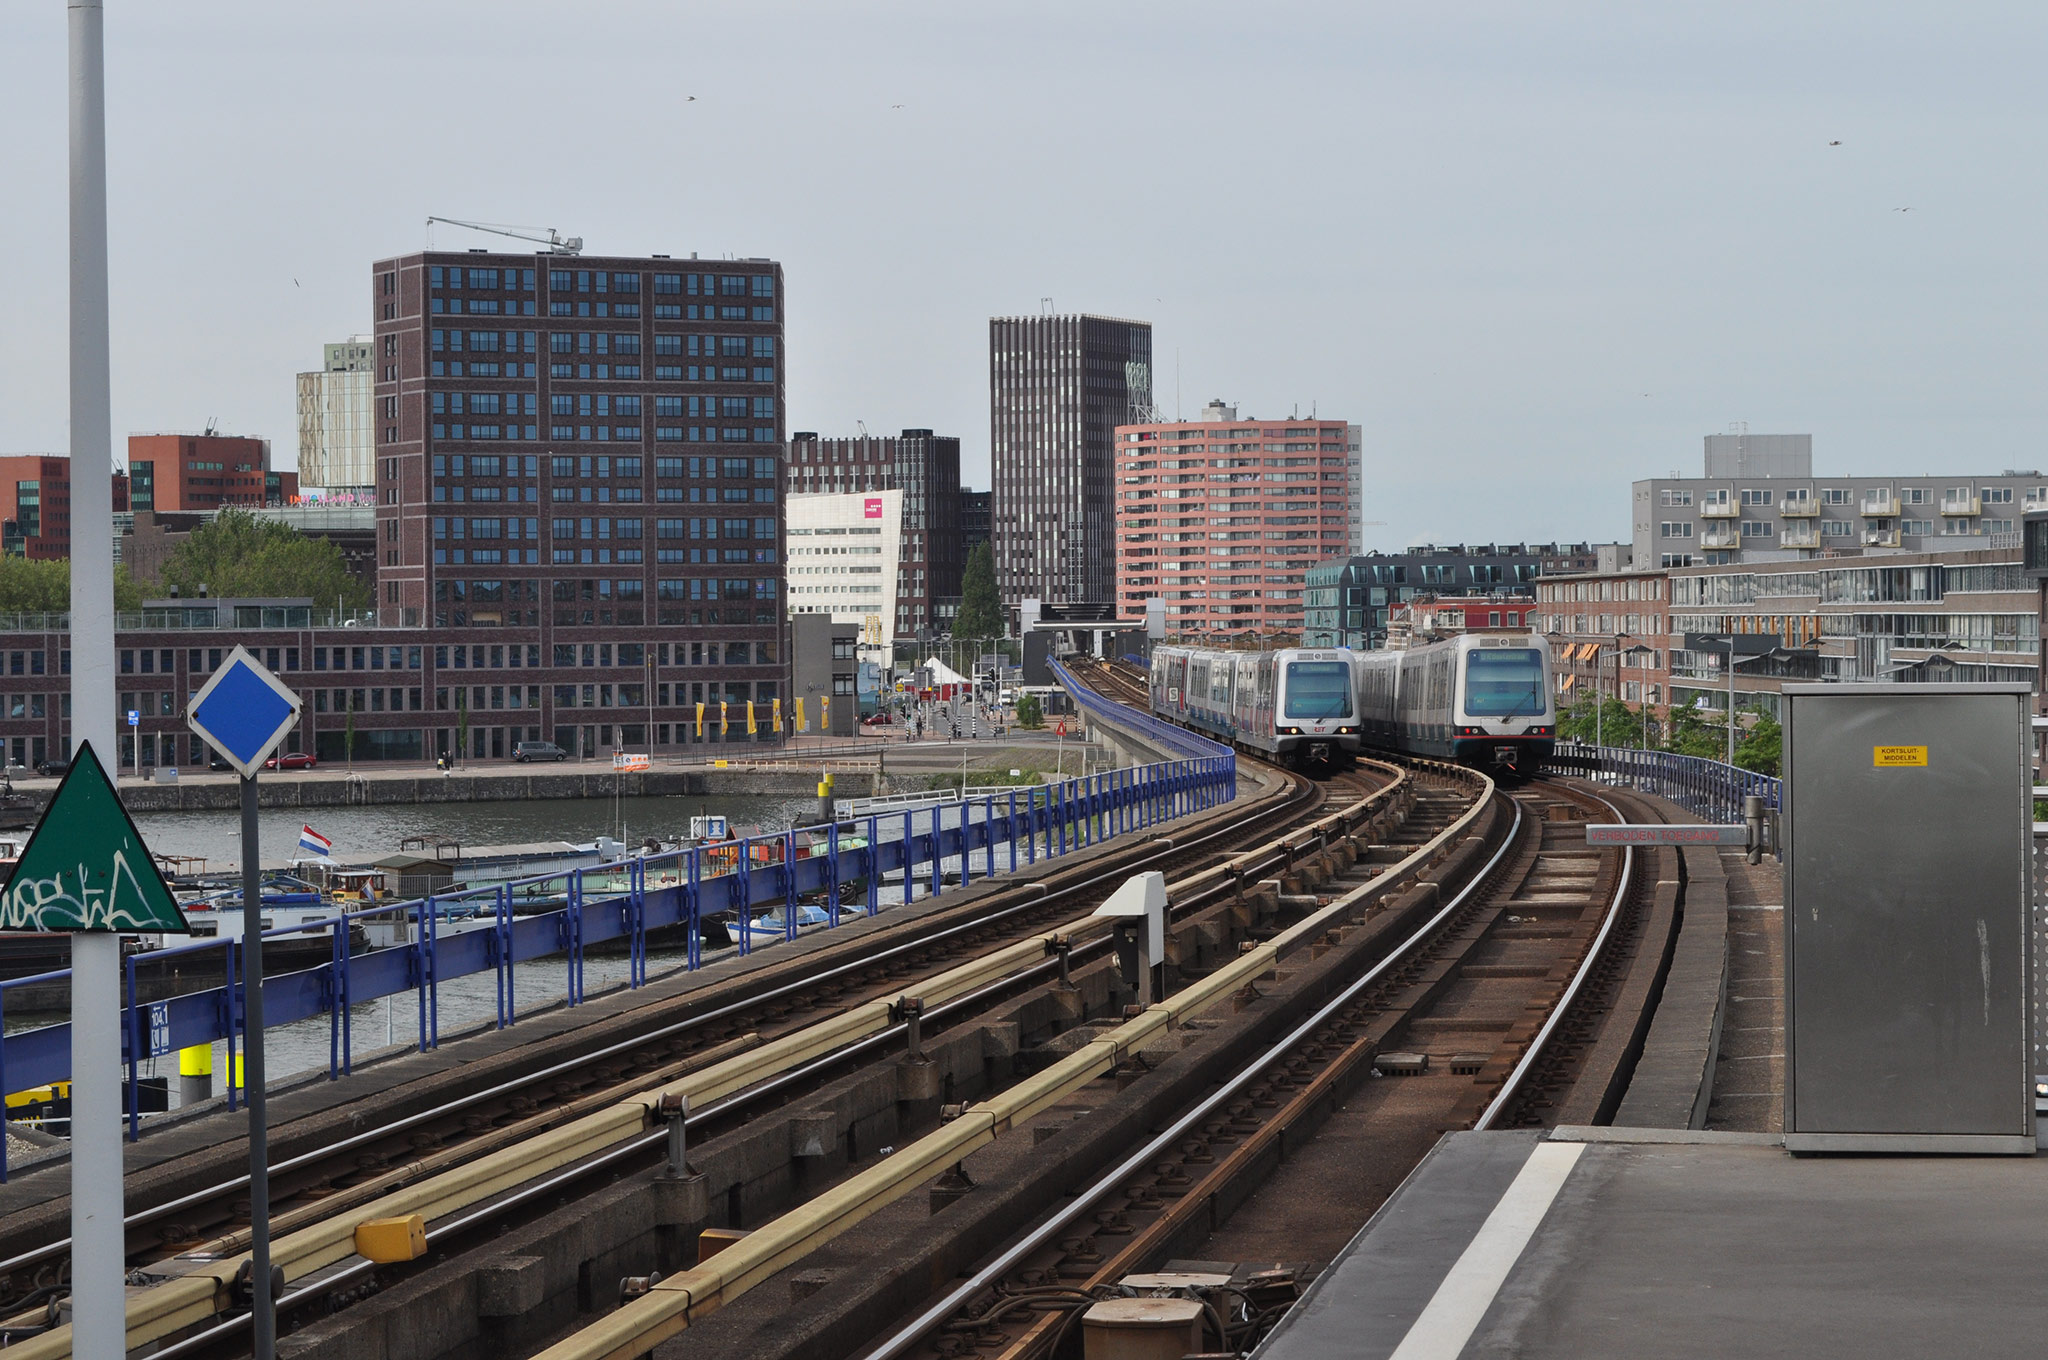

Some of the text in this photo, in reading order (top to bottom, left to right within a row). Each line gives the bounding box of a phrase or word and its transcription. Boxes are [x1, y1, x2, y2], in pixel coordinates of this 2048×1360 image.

[289, 494, 354, 504] INHOLLAND
[1591, 830, 1719, 841] VERBODEN TOEGANG
